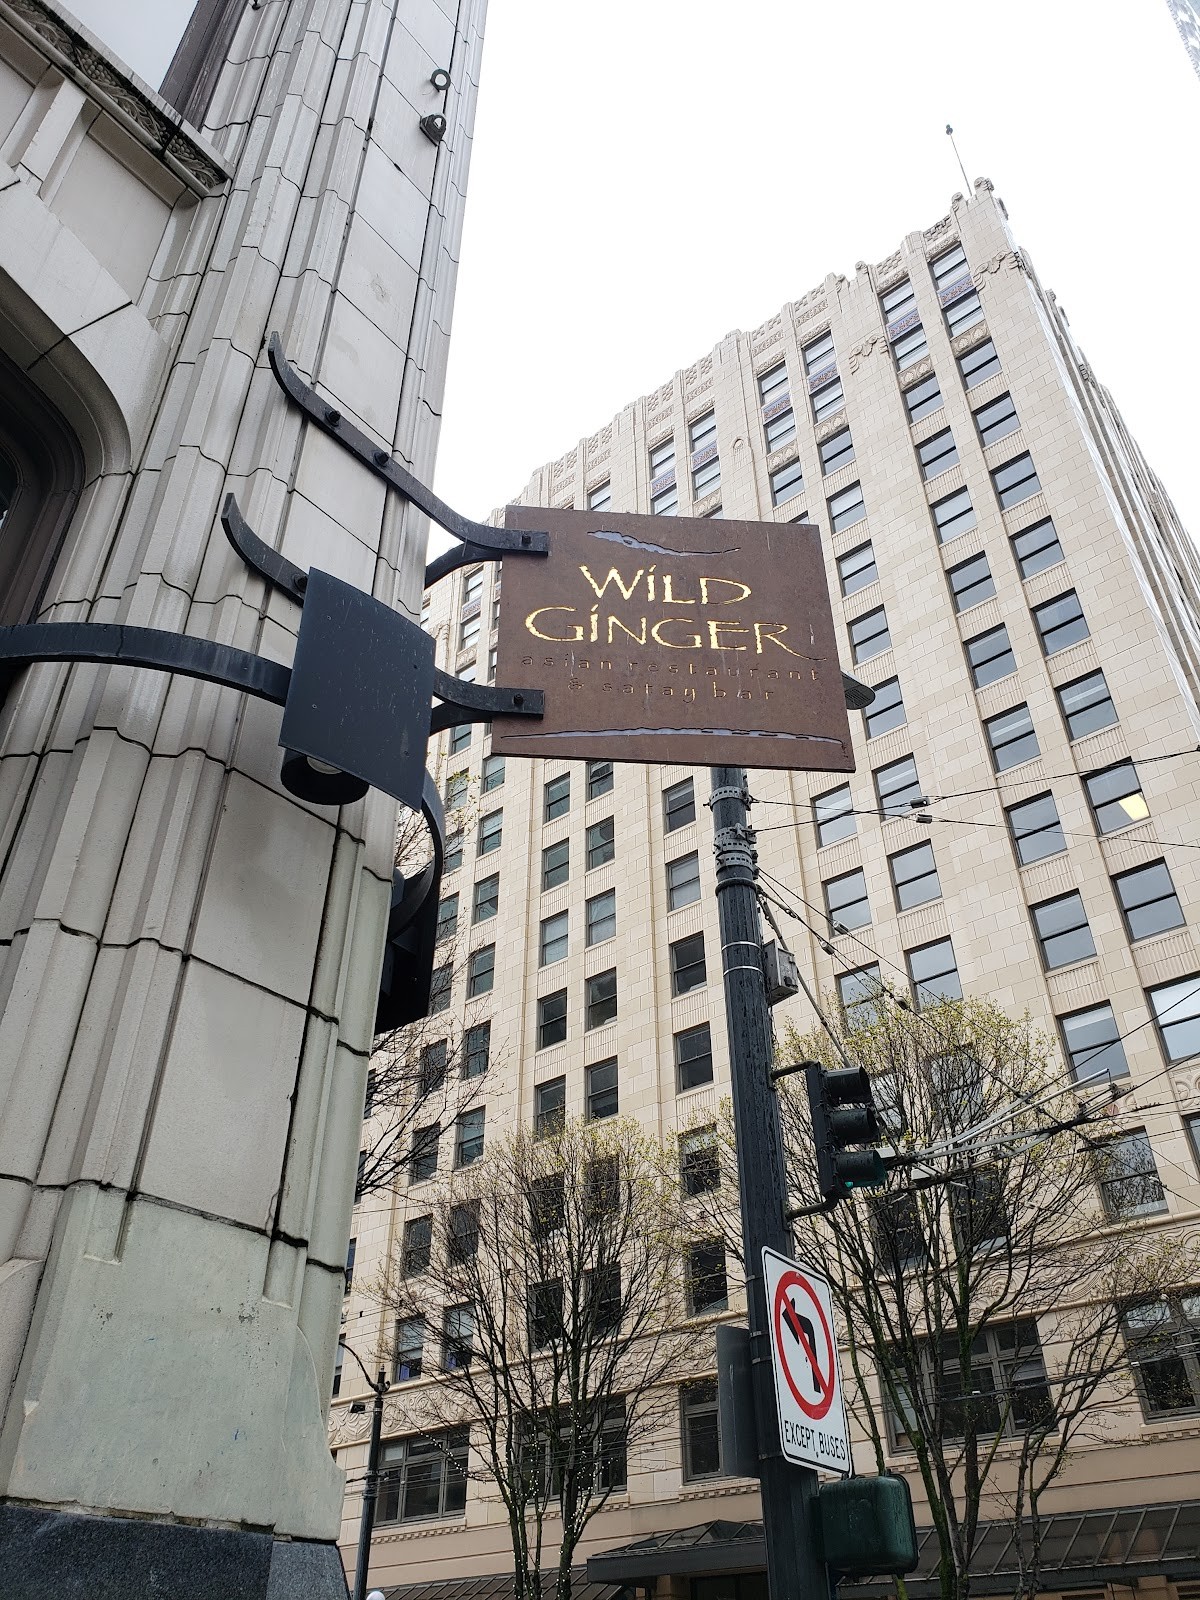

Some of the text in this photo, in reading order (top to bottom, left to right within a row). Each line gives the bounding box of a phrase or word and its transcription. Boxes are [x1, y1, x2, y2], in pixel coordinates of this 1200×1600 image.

[521, 655, 819, 681] asian restaurant
[602, 681, 696, 703] satay
[713, 682, 774, 700] bar
[784, 1420, 846, 1460] EXCEPT BUSES
